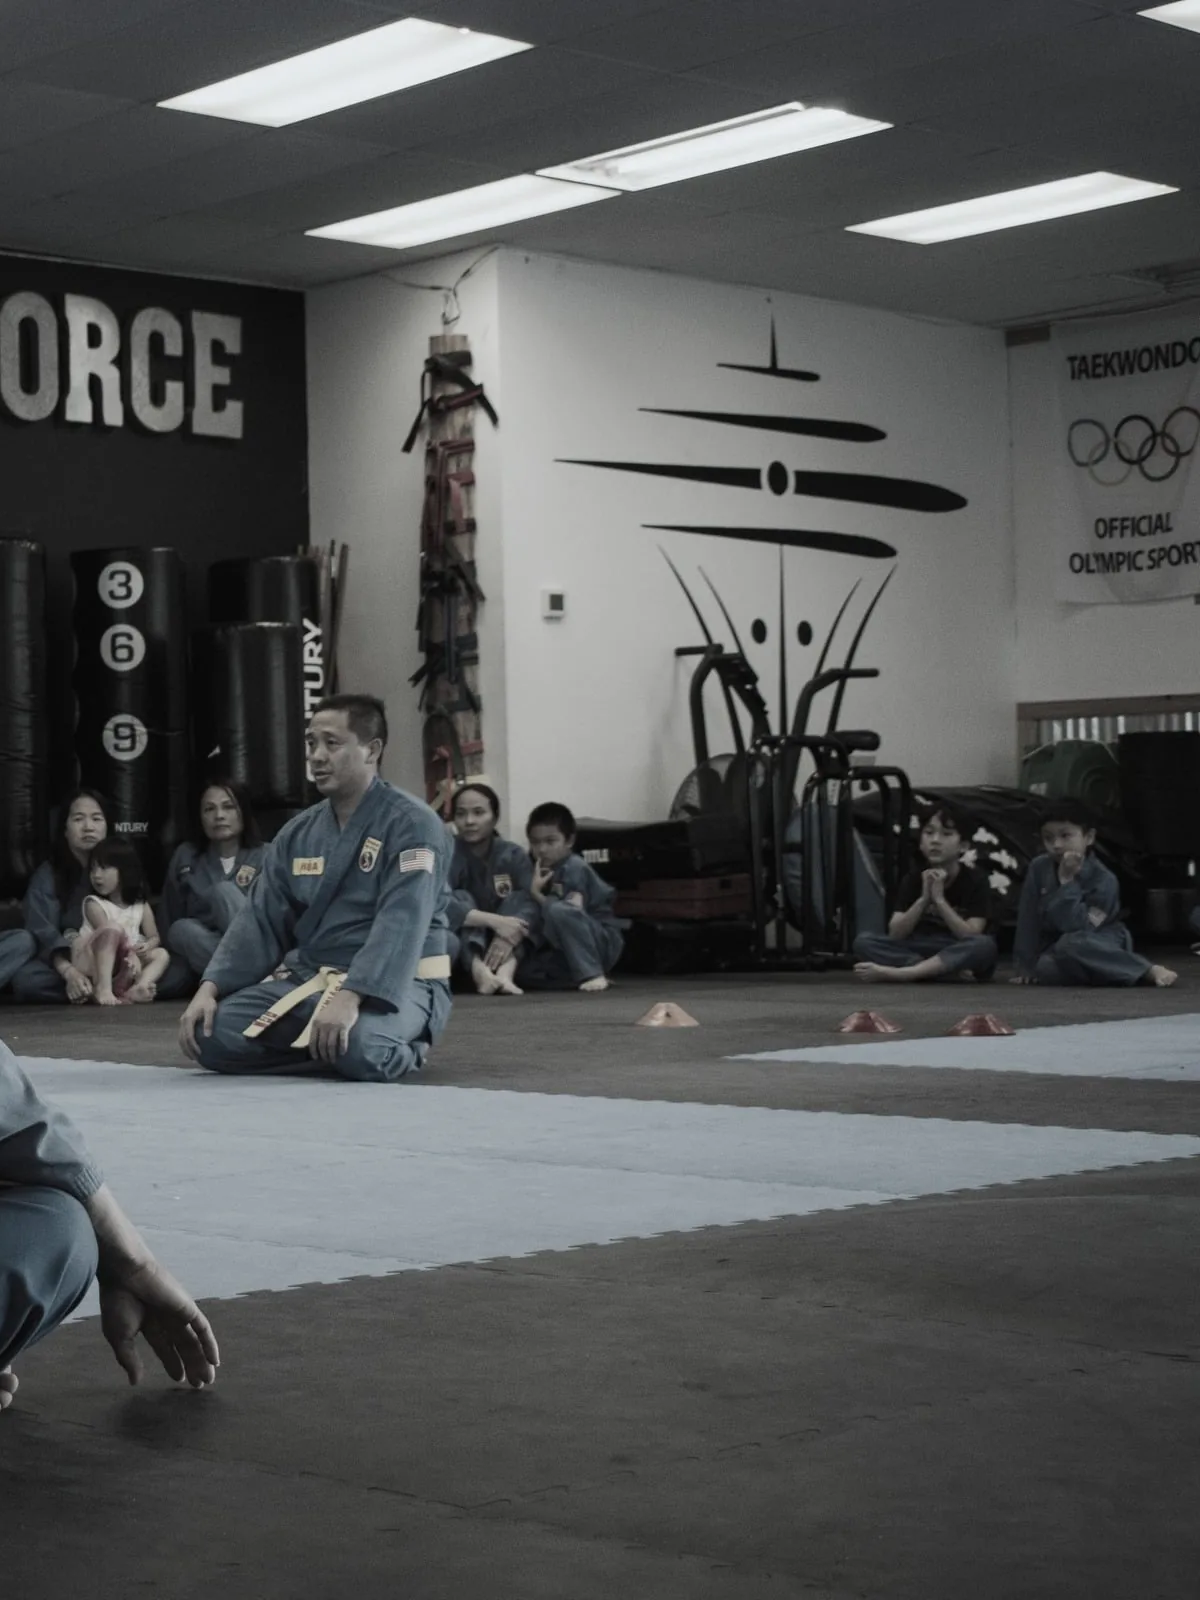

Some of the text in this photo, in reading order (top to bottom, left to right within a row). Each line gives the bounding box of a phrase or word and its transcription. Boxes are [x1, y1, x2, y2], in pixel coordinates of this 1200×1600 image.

[1067, 336, 1200, 381] TAEKWONDO
[1094, 511, 1173, 540] OFFICIAL
[1069, 550, 1144, 575] OLYMPIC
[108, 570, 132, 600] 3
[111, 632, 134, 663] 6
[114, 723, 136, 752] 9
